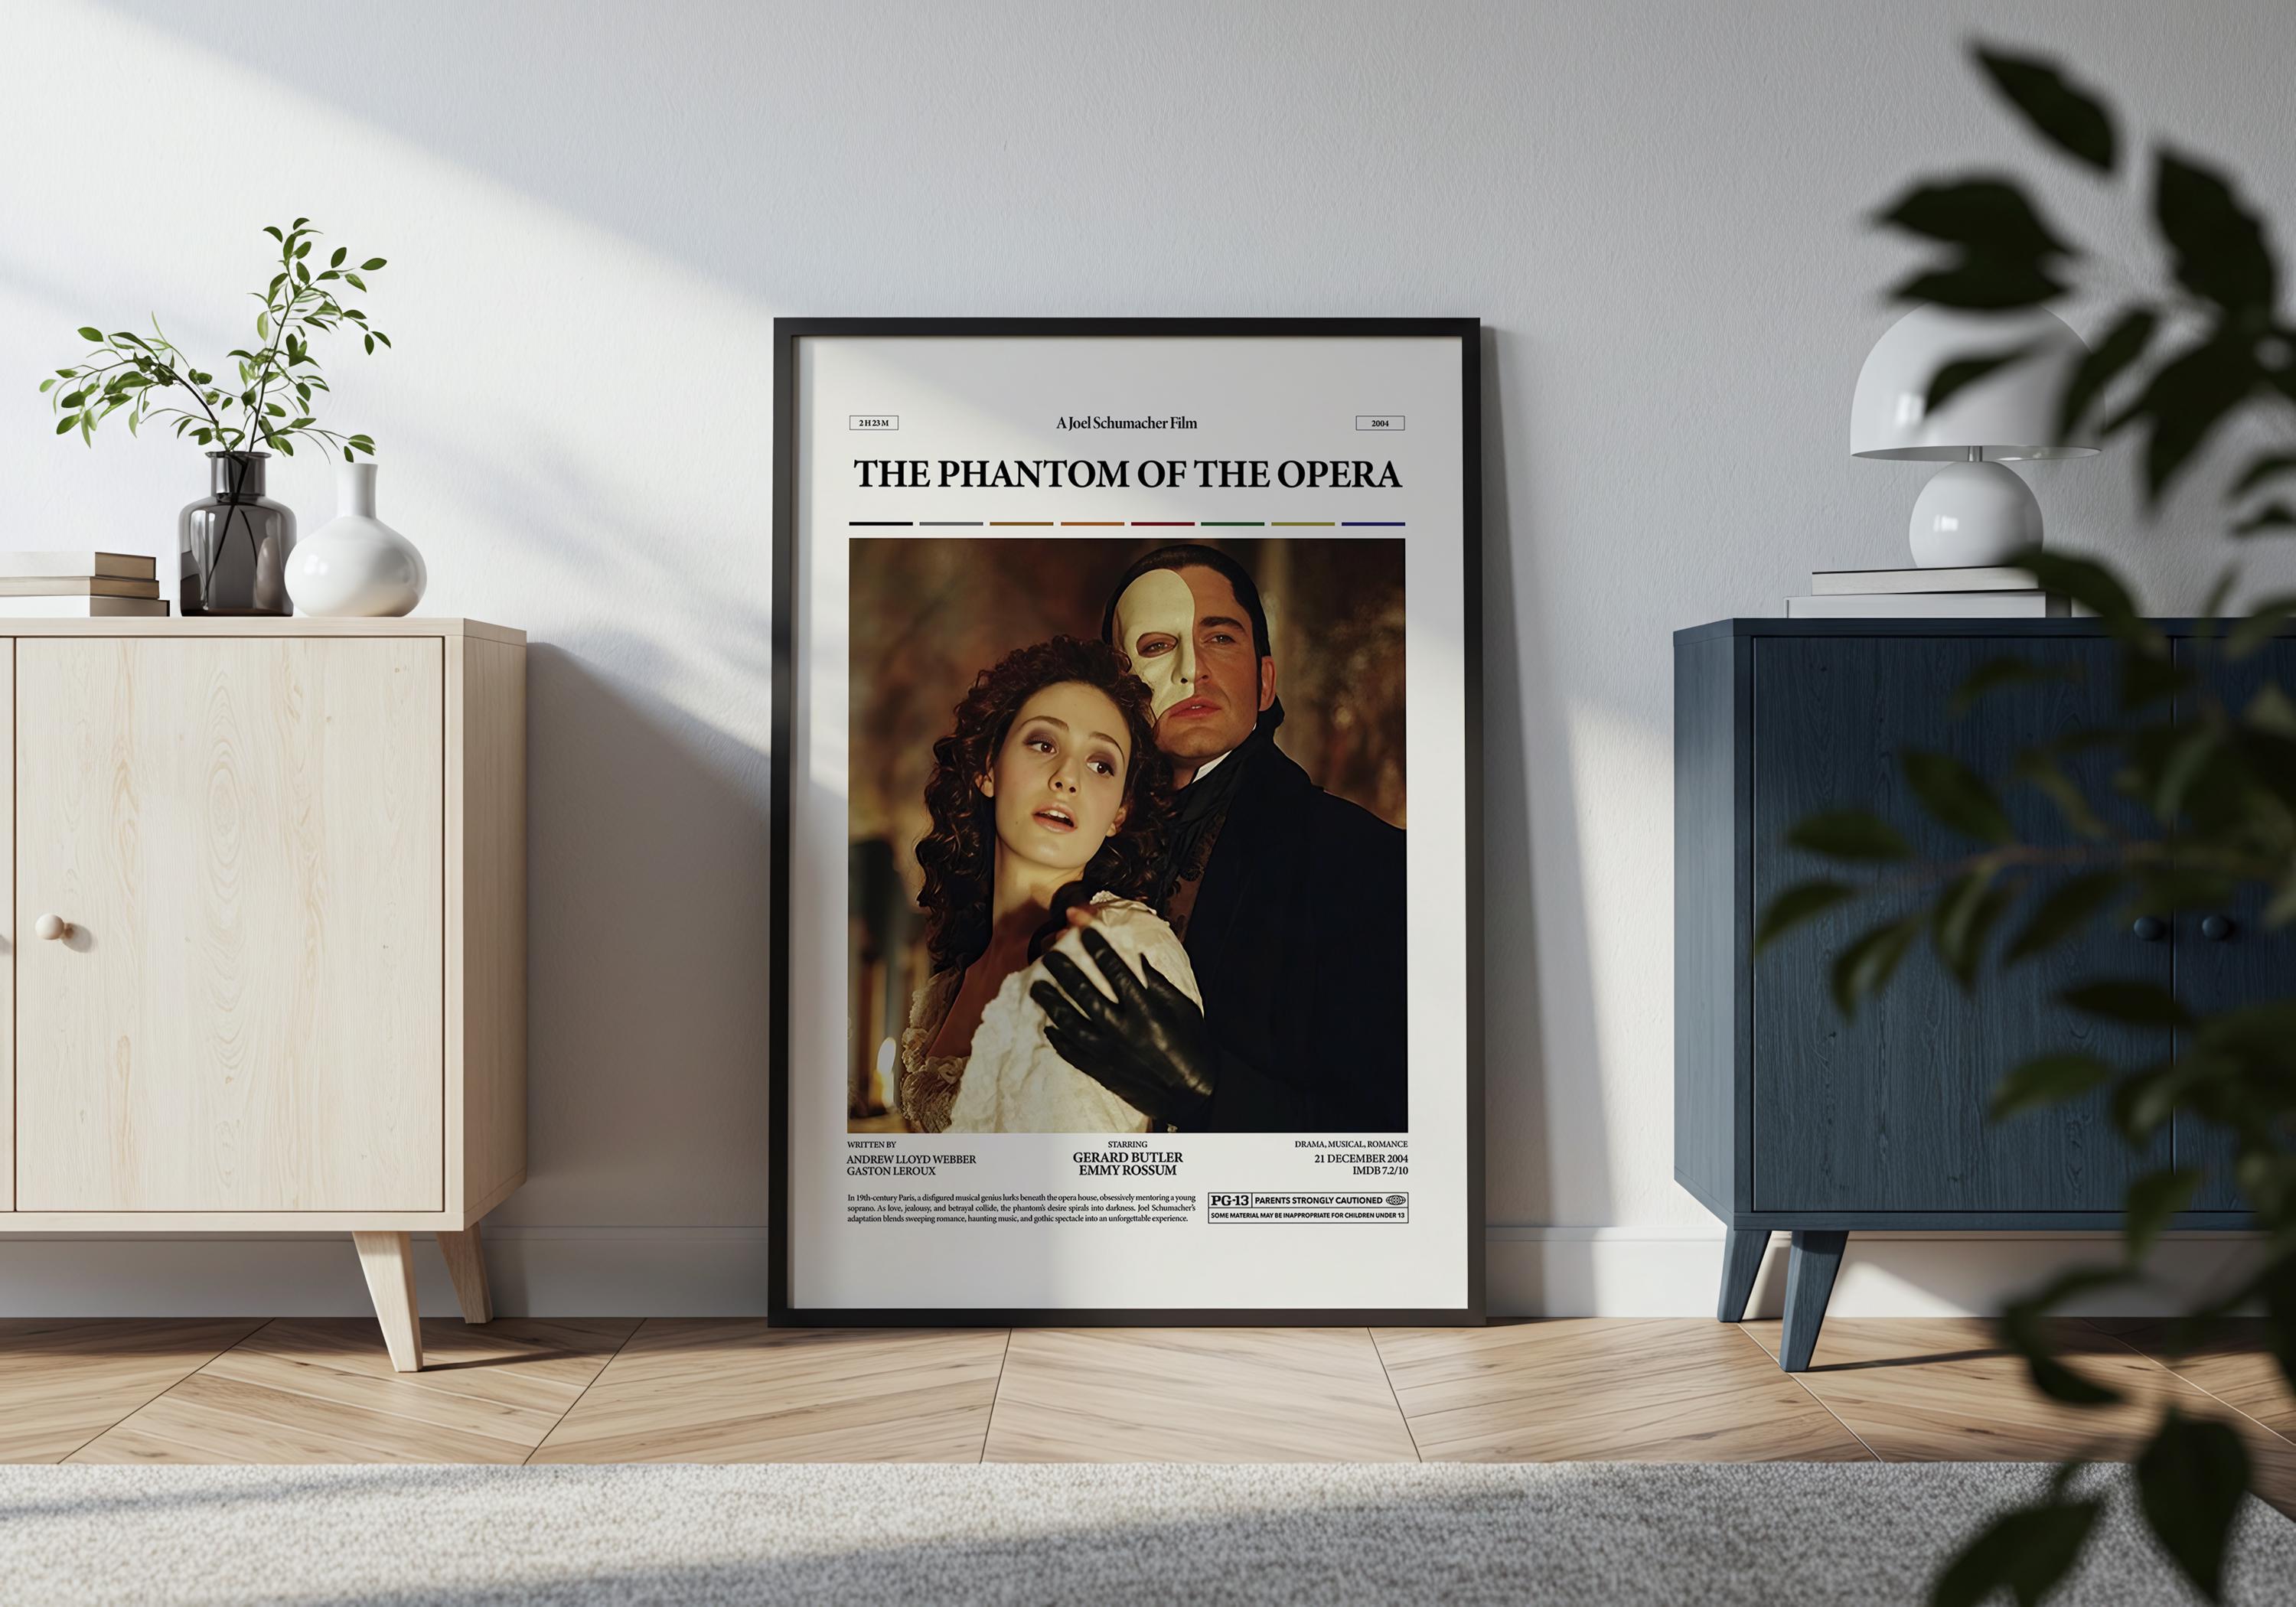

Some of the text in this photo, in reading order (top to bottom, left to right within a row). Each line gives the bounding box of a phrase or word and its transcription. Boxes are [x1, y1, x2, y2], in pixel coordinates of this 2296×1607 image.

[1056, 416, 1198, 432] A Joel Schumacher Film
[1371, 419, 1390, 428] 2004
[853, 458, 1404, 489] THE PHANTOM OF THE OPERA
[846, 1140, 897, 1149] WRITTEN BY
[1107, 1140, 1148, 1149] STARRING
[1295, 1140, 1408, 1149] DRAMA, MUSICAL, ROMANCE
[846, 1154, 977, 1165] ANDREW LLOYD WEBBER
[1072, 1152, 1184, 1164] GERARD BUTLER
[1314, 1153, 1409, 1164] 21 DECEMBER 2004
[846, 1165, 937, 1176] GASTON LEROUX
[1078, 1164, 1177, 1176] EMMY ROSSUM
[1352, 1165, 1409, 1176] IMDB 7.2/10
[856, 1193, 898, 1204] 19th-century
[898, 1194, 917, 1202] Paris,
[921, 1193, 954, 1204] disfigured
[955, 1193, 980, 1201] musical
[980, 1194, 1003, 1204] genius
[1003, 1193, 1019, 1201] lurks
[1019, 1193, 1046, 1201] beneath
[1046, 1193, 1058, 1201] the
[1058, 1195, 1077, 1204] opera
[1078, 1193, 1099, 1201] house,
[1099, 1193, 1135, 1204] obsessively
[1135, 1193, 1170, 1204] mentoring
[1175, 1195, 1196, 1204] young
[1210, 1195, 1250, 1206] PG-13
[1254, 1196, 1384, 1204] PARENTS STRONGLY CAUTIONED
[847, 1206, 876, 1214] soprano.
[887, 1204, 903, 1213] love,
[904, 1204, 932, 1214] jealousy,
[933, 1204, 947, 1212] and
[947, 1204, 974, 1214] betrayal
[975, 1204, 999, 1213] collide,
[1000, 1204, 1012, 1212] the
[1047, 1204, 1068, 1212] desire
[1068, 1204, 1090, 1214] spirals
[1091, 1204, 1104, 1212] into
[1105, 1204, 1137, 1212] darkness.
[1137, 1203, 1150, 1213] Joel
[847, 1214, 882, 1224] adaptation
[882, 1214, 905, 1223] blends
[905, 1214, 936, 1224] sweeping
[967, 1214, 997, 1224] haunting
[997, 1214, 1019, 1223] music,
[1019, 1214, 1033, 1222] and
[1033, 1214, 1055, 1224] gothic
[1055, 1214, 1084, 1224] spectacle
[1108, 1214, 1152, 1224] unforgettable
[1151, 1214, 1189, 1224] experience.
